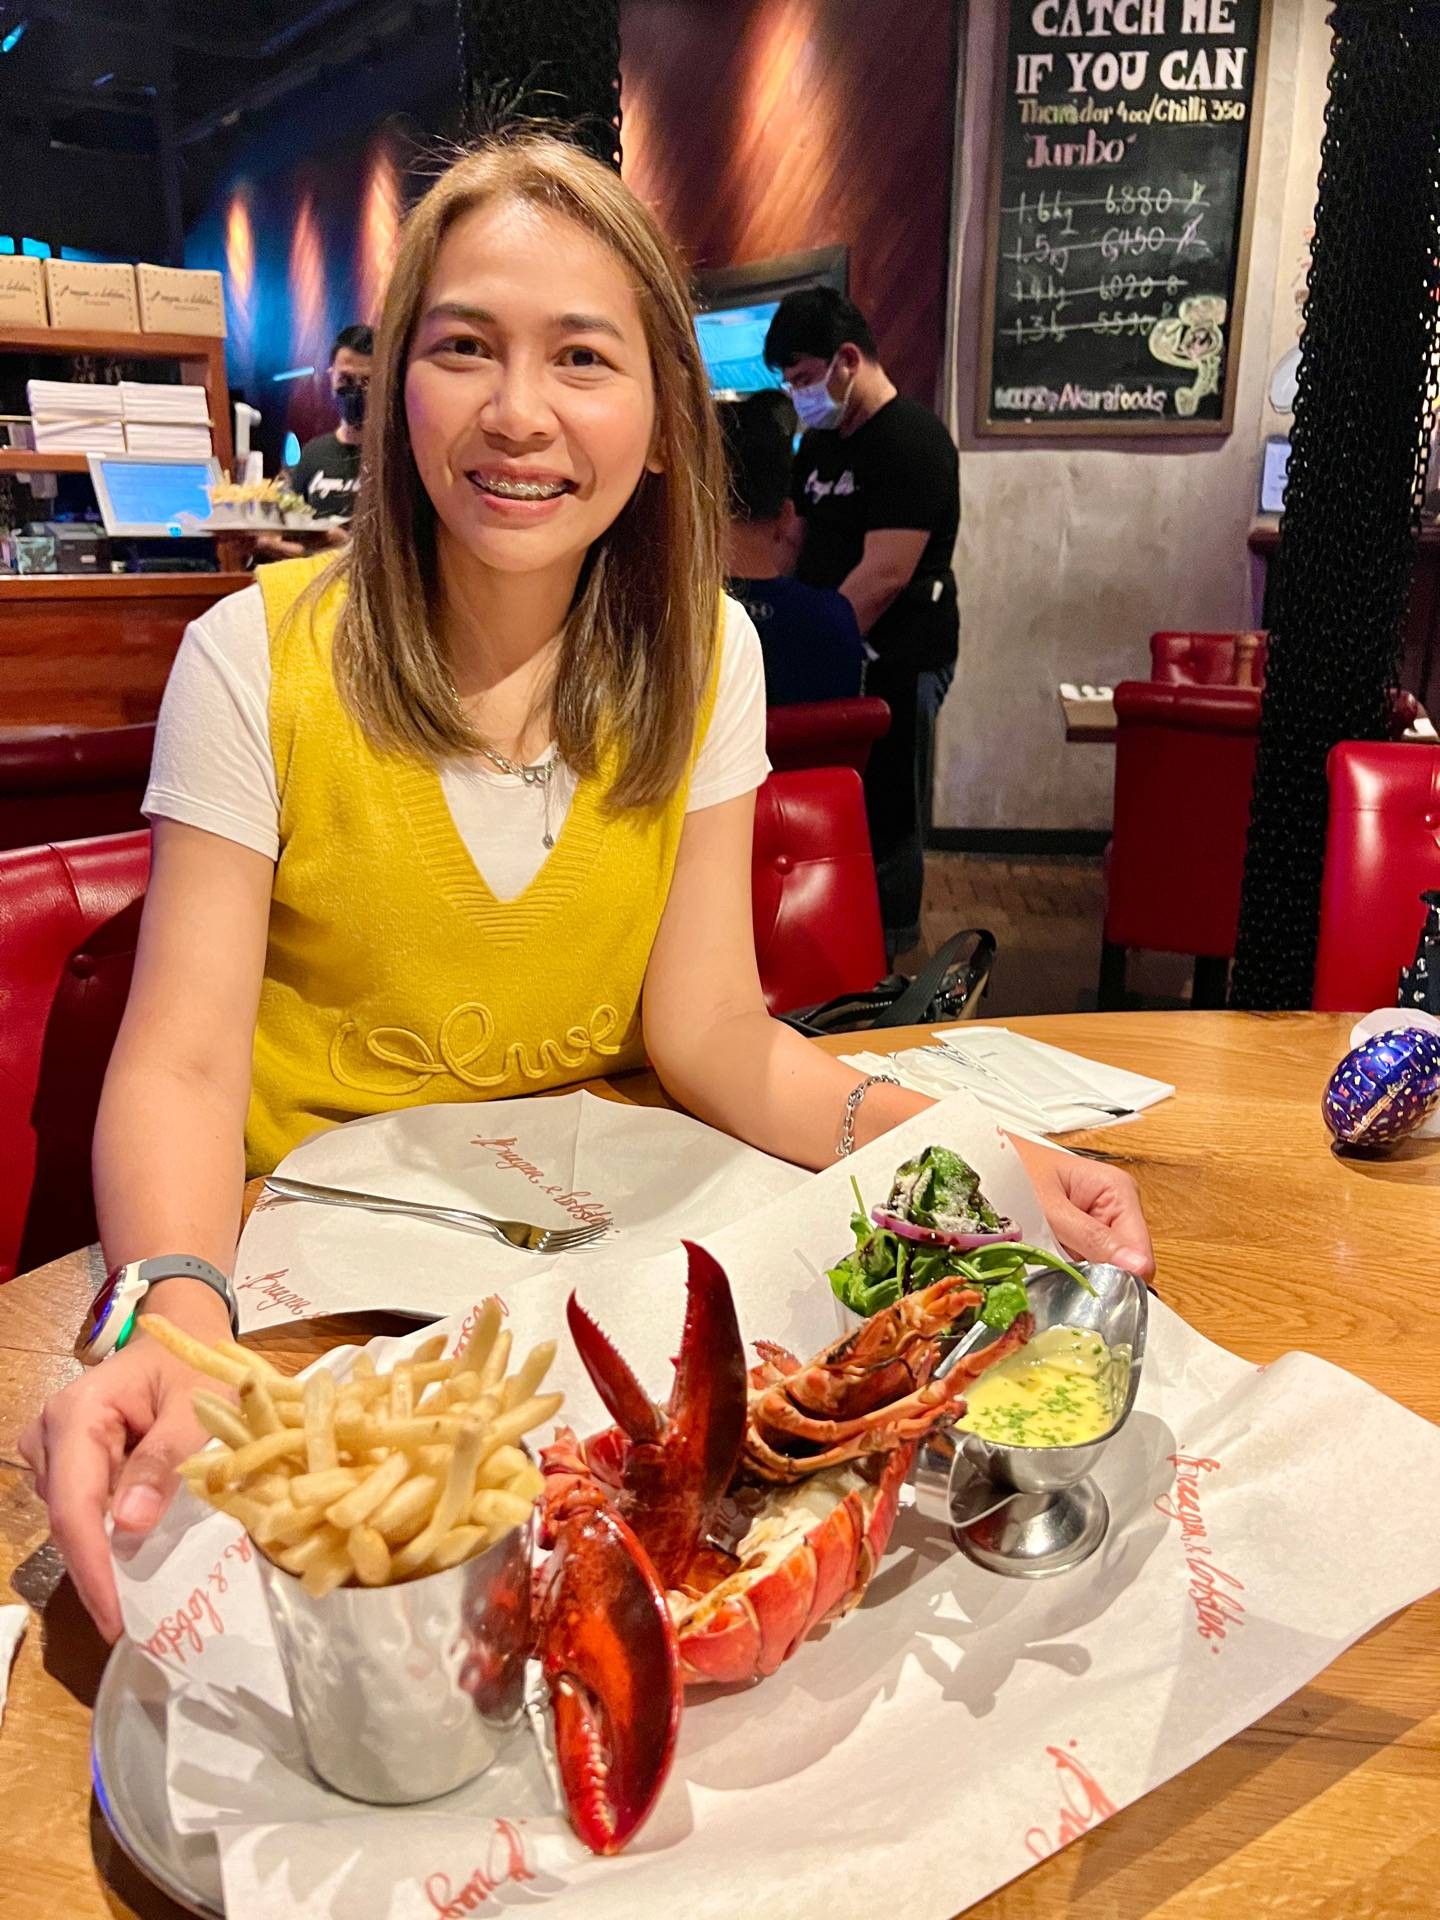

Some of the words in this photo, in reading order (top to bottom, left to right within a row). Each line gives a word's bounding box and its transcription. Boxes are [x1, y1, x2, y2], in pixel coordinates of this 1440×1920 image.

[1031, 0, 1166, 36] CATCH
[1181, 0, 1236, 34] ME
[1015, 54, 1053, 95] IF
[1067, 50, 1149, 93] YOU
[1159, 47, 1248, 90] CAN
[1211, 101, 1246, 121] 350
